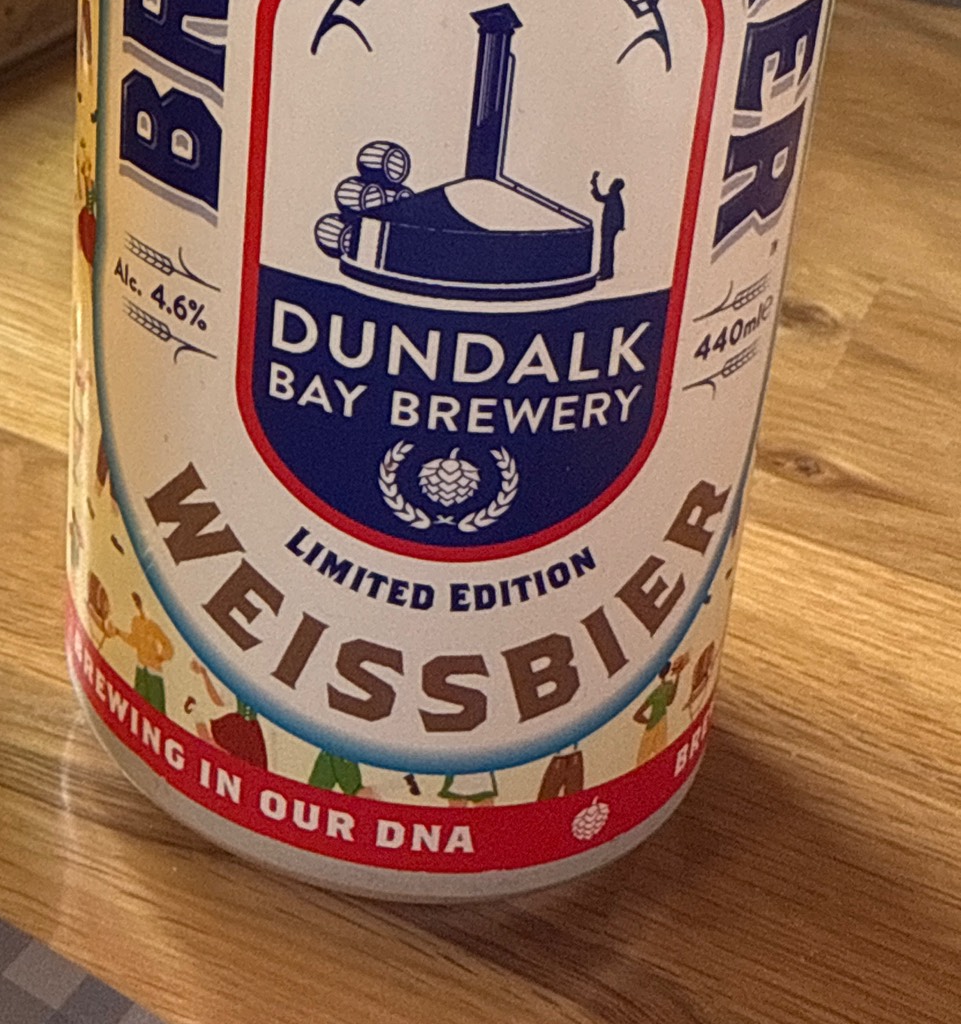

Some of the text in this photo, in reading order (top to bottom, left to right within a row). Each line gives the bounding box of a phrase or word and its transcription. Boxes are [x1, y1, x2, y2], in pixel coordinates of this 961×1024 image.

[114, 257, 208, 331] Alc. 4.6%
[270, 298, 651, 385] DUNDALK
[267, 361, 643, 435] BAY BREWERY
[144, 462, 733, 733] WEISSBIER
[284, 525, 598, 612] LIMITED EDITION
[199, 758, 242, 805] IN
[258, 788, 355, 842] OUR
[374, 818, 475, 854] DNA
